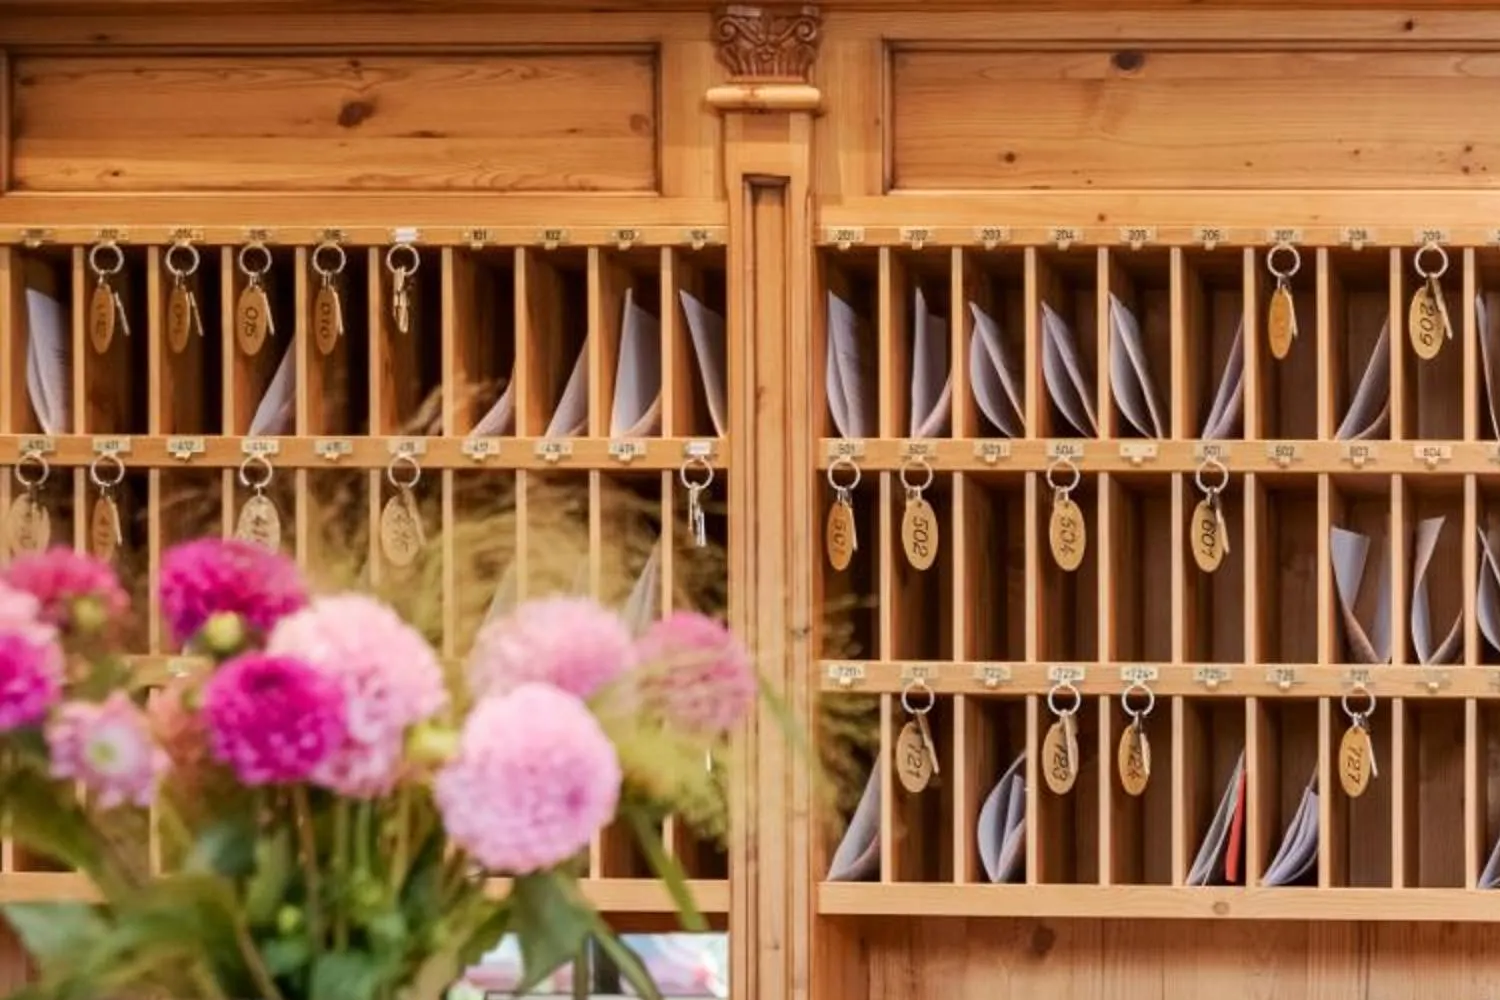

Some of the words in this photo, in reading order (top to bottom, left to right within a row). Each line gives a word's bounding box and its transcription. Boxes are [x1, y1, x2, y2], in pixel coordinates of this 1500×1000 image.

[982, 229, 1001, 241] 203
[1055, 229, 1074, 240] 204
[1201, 229, 1220, 240] 206
[1422, 230, 1441, 241] 209
[244, 305, 259, 338] 015
[1419, 302, 1436, 348] 209
[837, 444, 855, 455] 501
[1349, 446, 1368, 457] 603
[1423, 447, 1441, 457] 604
[833, 516, 848, 555] 501
[912, 518, 930, 558] 502
[1060, 517, 1078, 556] 504
[1200, 519, 1217, 559] 601
[911, 666, 929, 677] 721
[908, 741, 924, 781] 721
[1052, 744, 1070, 784] 723
[1347, 744, 1365, 785] 727
